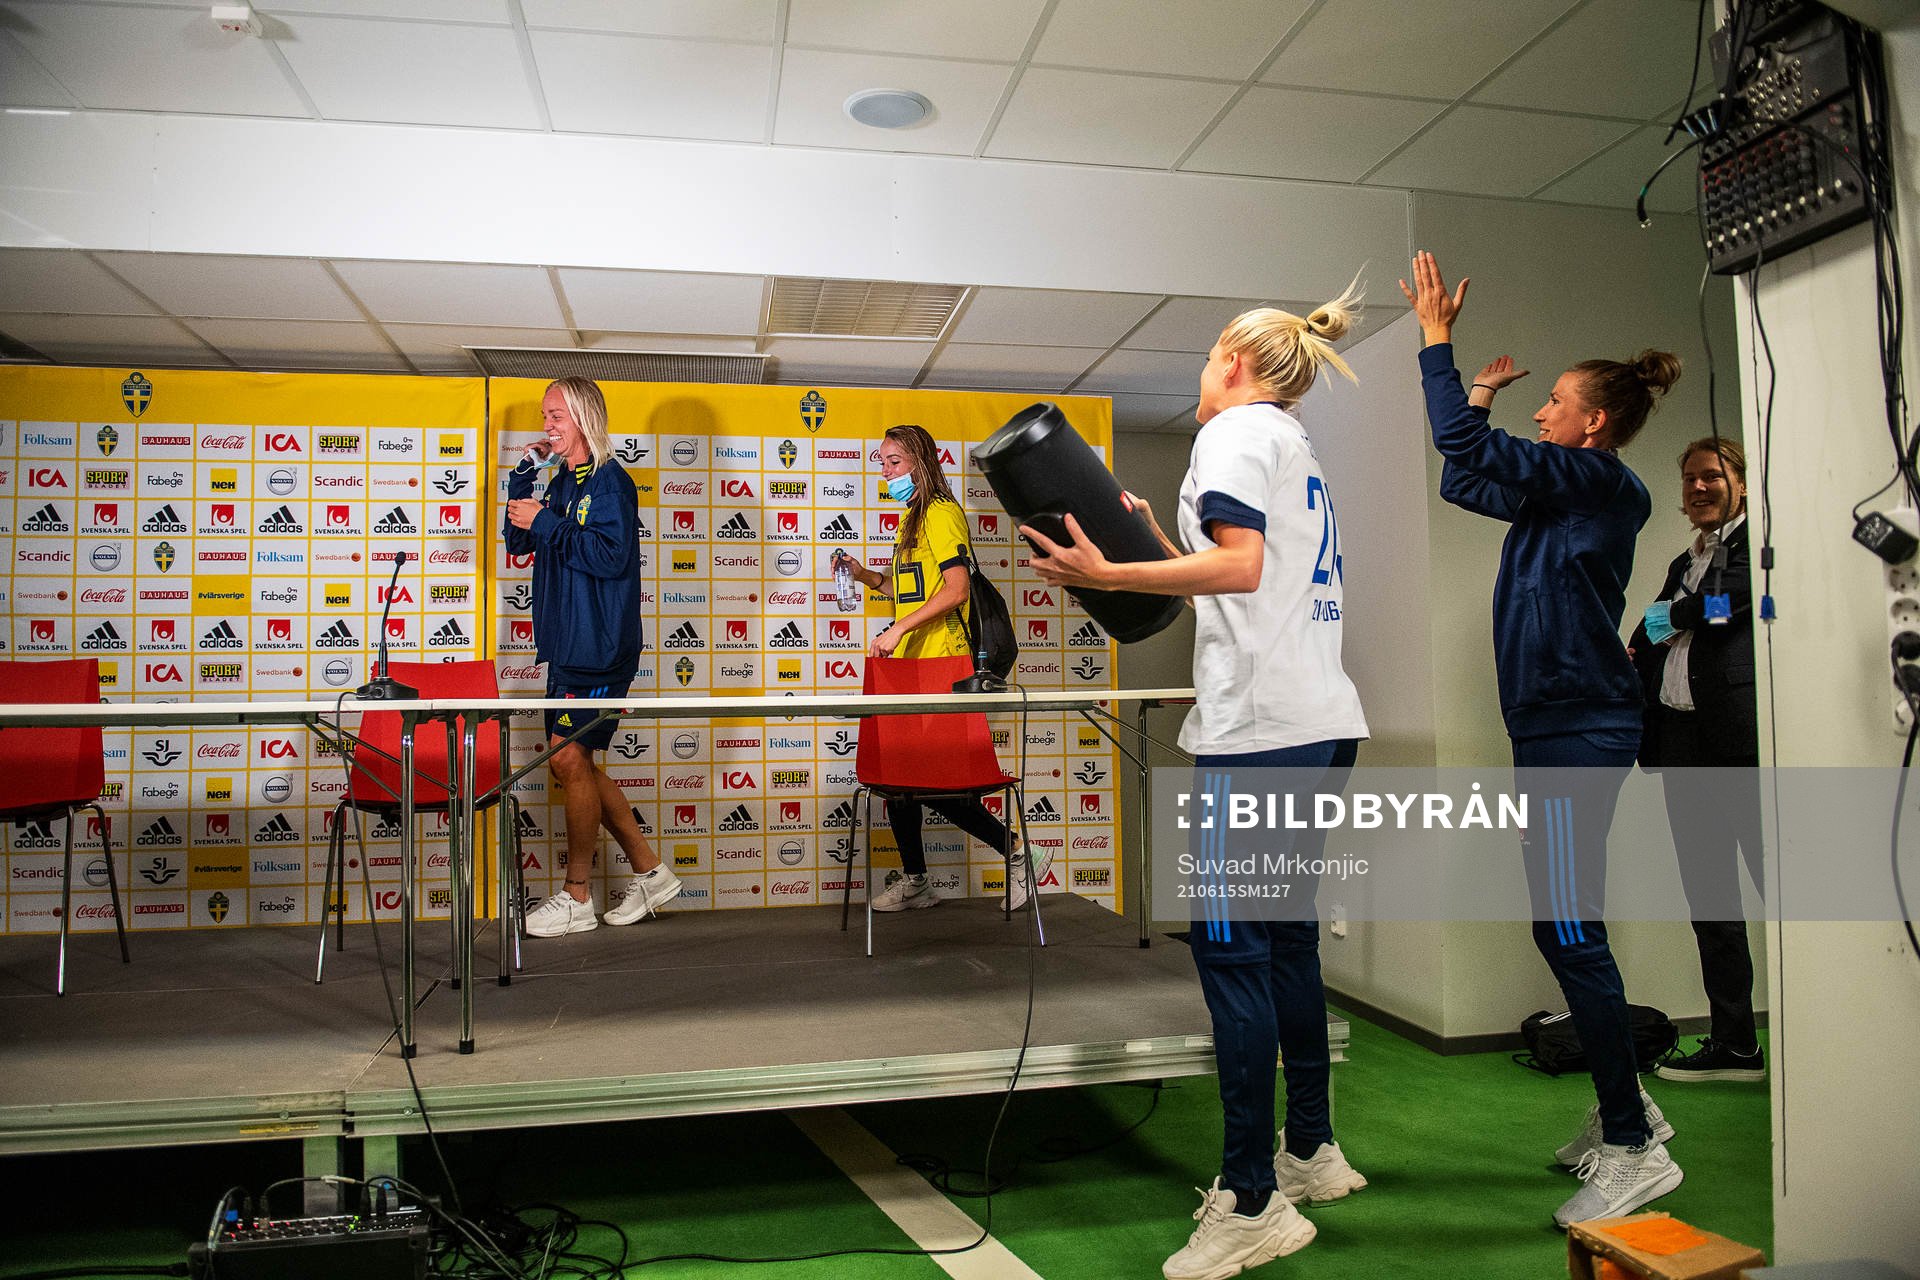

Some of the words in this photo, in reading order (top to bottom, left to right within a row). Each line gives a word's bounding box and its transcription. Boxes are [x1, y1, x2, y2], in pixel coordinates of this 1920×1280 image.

[24, 434, 72, 445] Folksam
[142, 437, 190, 445] BAUHAUS
[201, 435, 246, 449] Coca-Cola
[265, 434, 302, 451] ICA
[320, 435, 359, 447] SPORT
[625, 439, 637, 450] SJ
[379, 441, 412, 451] Fabege
[716, 448, 757, 458] Folksam
[29, 469, 67, 487] ICA
[87, 471, 127, 484] SPORT
[148, 475, 182, 487] Fabege
[445, 470, 457, 481] SJ
[315, 476, 363, 487] Scandic
[664, 482, 703, 495] Coca-Cola
[721, 480, 754, 497] ICA
[770, 483, 805, 494] SPORT
[824, 487, 854, 497] Fabege
[23, 522, 68, 532] adidas
[143, 522, 187, 533] adidas
[259, 522, 302, 533] adidas
[374, 523, 416, 533] adidas
[717, 529, 756, 539] adidas
[820, 530, 858, 540] adidas
[18, 551, 71, 562] Scandic
[257, 552, 303, 562] Folksam
[429, 550, 471, 563] Coca-Cola
[715, 557, 759, 566] Scandic
[81, 589, 127, 603] Coca-Cola
[378, 586, 413, 603] ICA
[431, 585, 468, 598] SPORT
[516, 585, 528, 596] SJ
[261, 591, 297, 602] Fabege
[663, 593, 705, 603] Folksam
[769, 592, 807, 605] Coca-Cola
[1024, 590, 1054, 606] ICA
[81, 639, 127, 650] adidas
[199, 638, 243, 648] adidas
[315, 638, 359, 647] adidas
[429, 636, 470, 645] adidas
[665, 639, 704, 648] adidas
[770, 638, 808, 647] adidas
[1069, 636, 1105, 646] adidas
[1082, 657, 1093, 666] SJ
[146, 664, 183, 682] ICA
[202, 665, 241, 677] SPORT
[501, 666, 541, 679] Coca-Cola
[722, 667, 753, 677] Fabege
[825, 661, 858, 678] ICA
[1019, 663, 1059, 673] Scandic
[625, 734, 637, 745] SJ
[836, 731, 847, 741] SJ
[1026, 735, 1055, 745] Fabege
[156, 740, 169, 751] SJ
[770, 738, 811, 748] Folksam
[198, 744, 241, 758] Coca-Cola
[261, 740, 298, 758] ICA
[1084, 762, 1095, 772] SJ
[665, 776, 705, 789] Coca-Cola
[723, 772, 756, 789] ICA
[773, 771, 808, 783] SPORT
[826, 774, 857, 785] Fabege
[143, 787, 178, 798] Fabege
[1024, 813, 1060, 822] adidas
[719, 821, 758, 831] adidas
[137, 834, 182, 845] adidas
[255, 830, 299, 842] adidas
[15, 837, 60, 848] adidas
[837, 839, 847, 849] SJ
[925, 843, 964, 852] Folksam
[1072, 836, 1109, 849] Coca-Cola
[717, 849, 761, 859] Scandic
[153, 858, 167, 869] SJ
[254, 861, 300, 872] Folksam
[13, 867, 64, 879] Scandic
[1075, 871, 1108, 881] SPORT
[772, 882, 811, 895] Coca-Cola
[135, 905, 183, 913] BAUHAUS
[260, 901, 295, 912] Fabege
